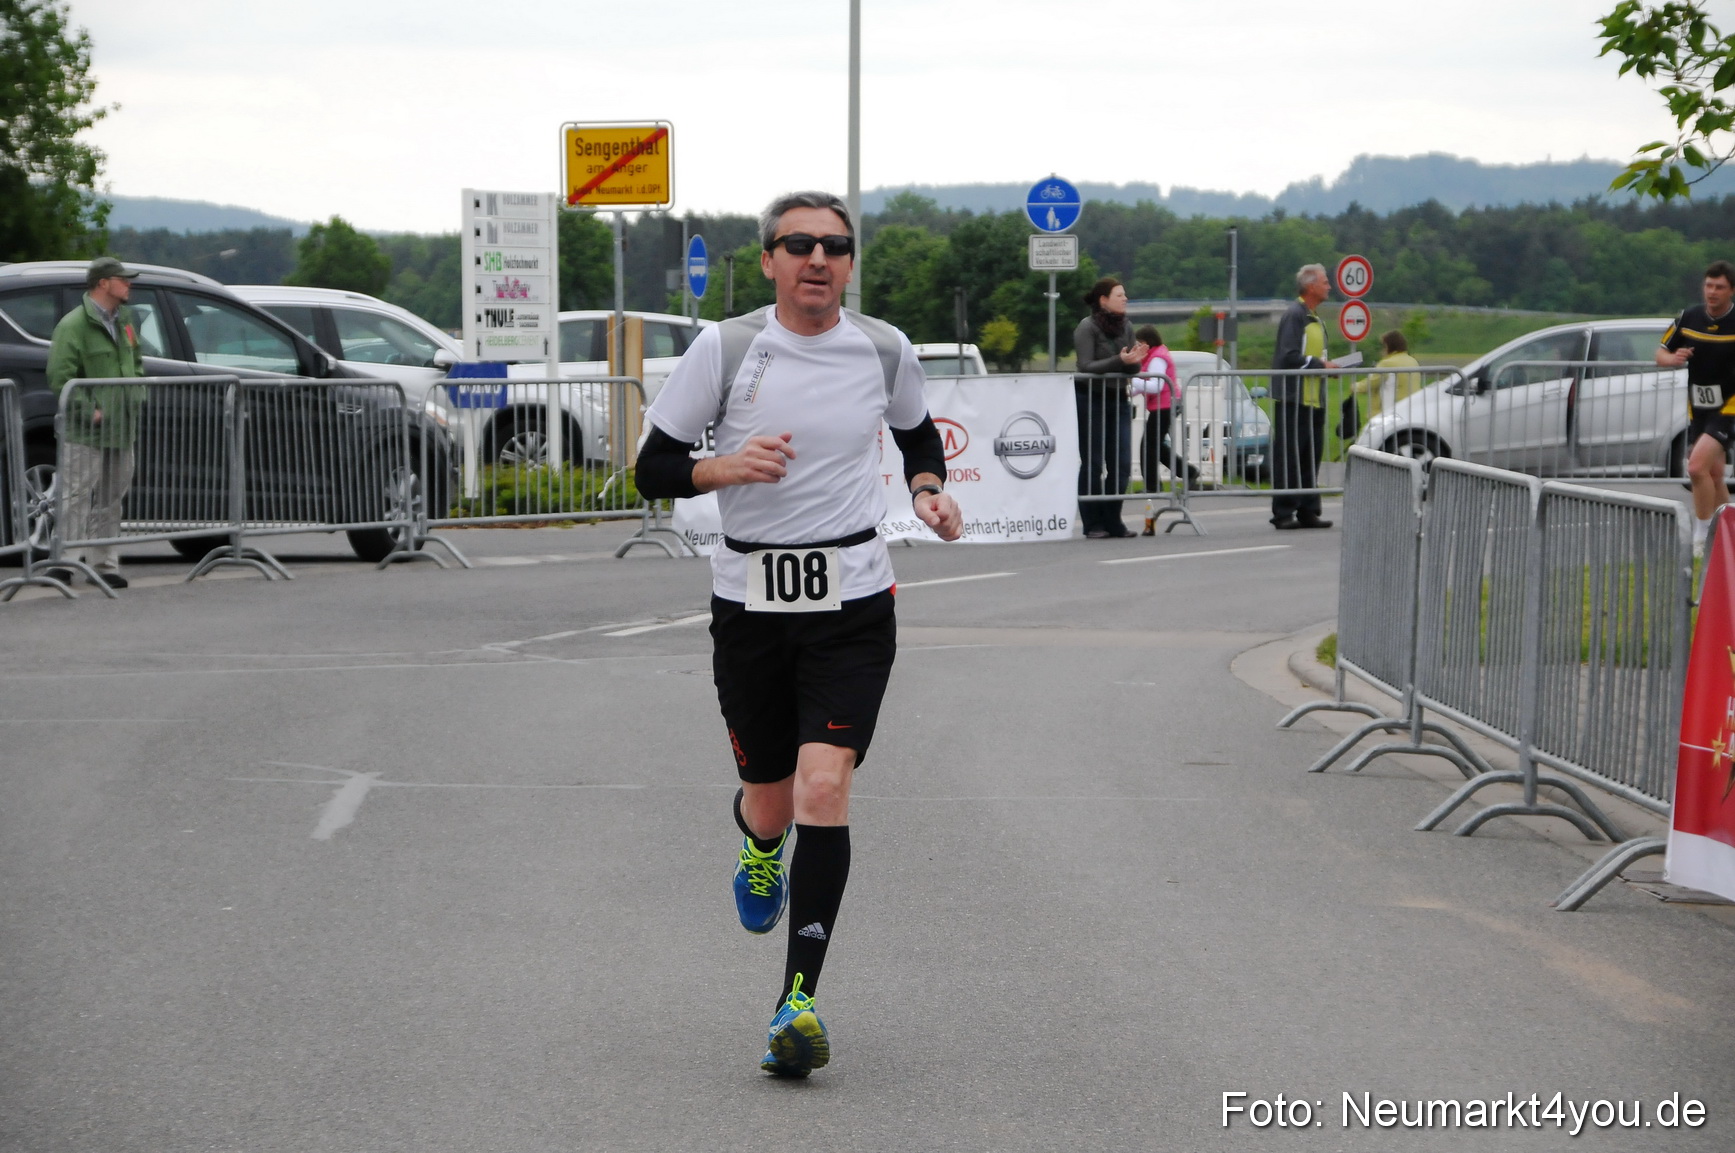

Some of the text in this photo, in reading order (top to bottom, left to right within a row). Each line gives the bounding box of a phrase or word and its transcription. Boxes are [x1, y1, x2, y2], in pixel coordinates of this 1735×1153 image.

[575, 136, 660, 161] Sengenthal
[586, 163, 648, 176] am Anger
[596, 185, 633, 195] Neumarkt
[1345, 267, 1365, 286] 60
[484, 308, 514, 328] THULE
[743, 359, 766, 402] SEEBERGER
[1697, 387, 1715, 404] 30
[1000, 439, 1050, 452] NISSAN
[947, 467, 981, 483] TORS
[762, 550, 829, 603] 108
[797, 929, 827, 941] adidas
